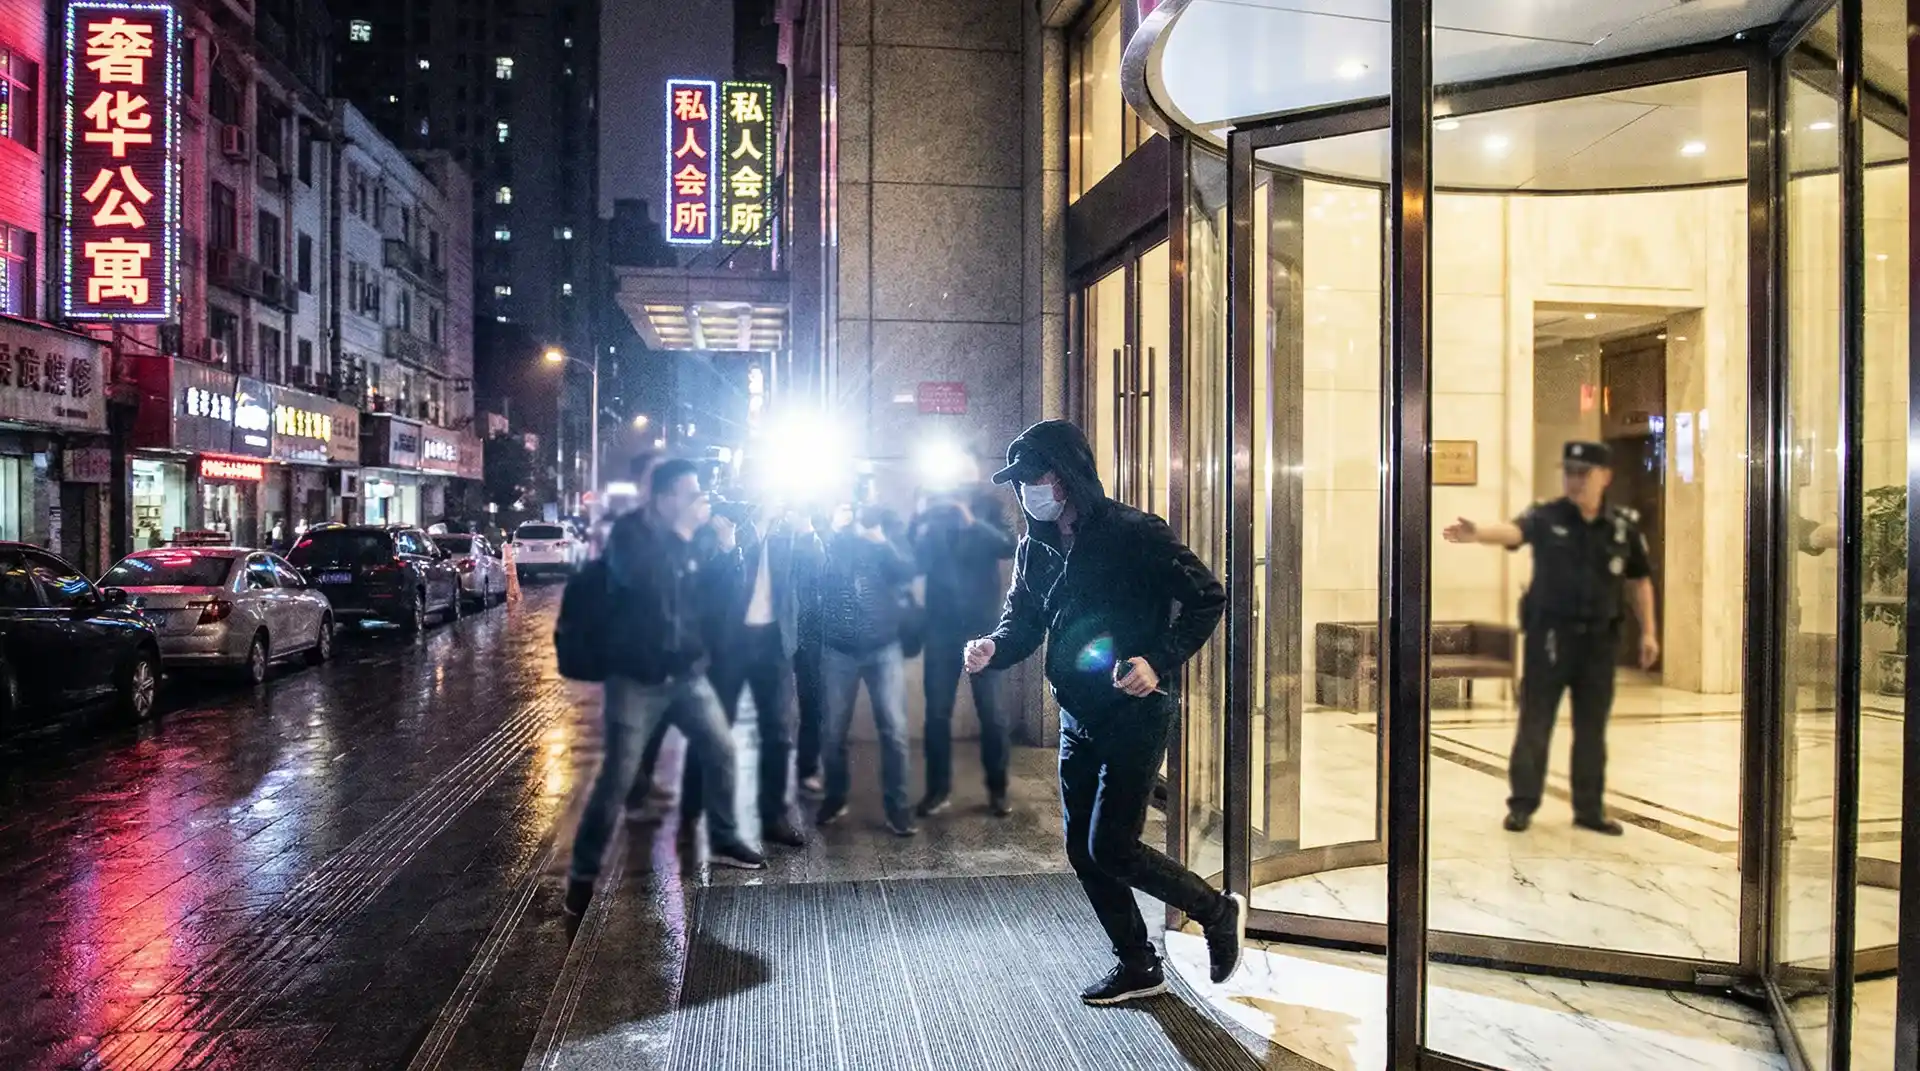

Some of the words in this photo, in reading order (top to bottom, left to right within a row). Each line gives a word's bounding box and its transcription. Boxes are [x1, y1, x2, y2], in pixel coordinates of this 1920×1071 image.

[83, 17, 153, 306] 奢华公寓
[674, 89, 709, 235] 私人会所
[730, 91, 764, 235] 私人会所
